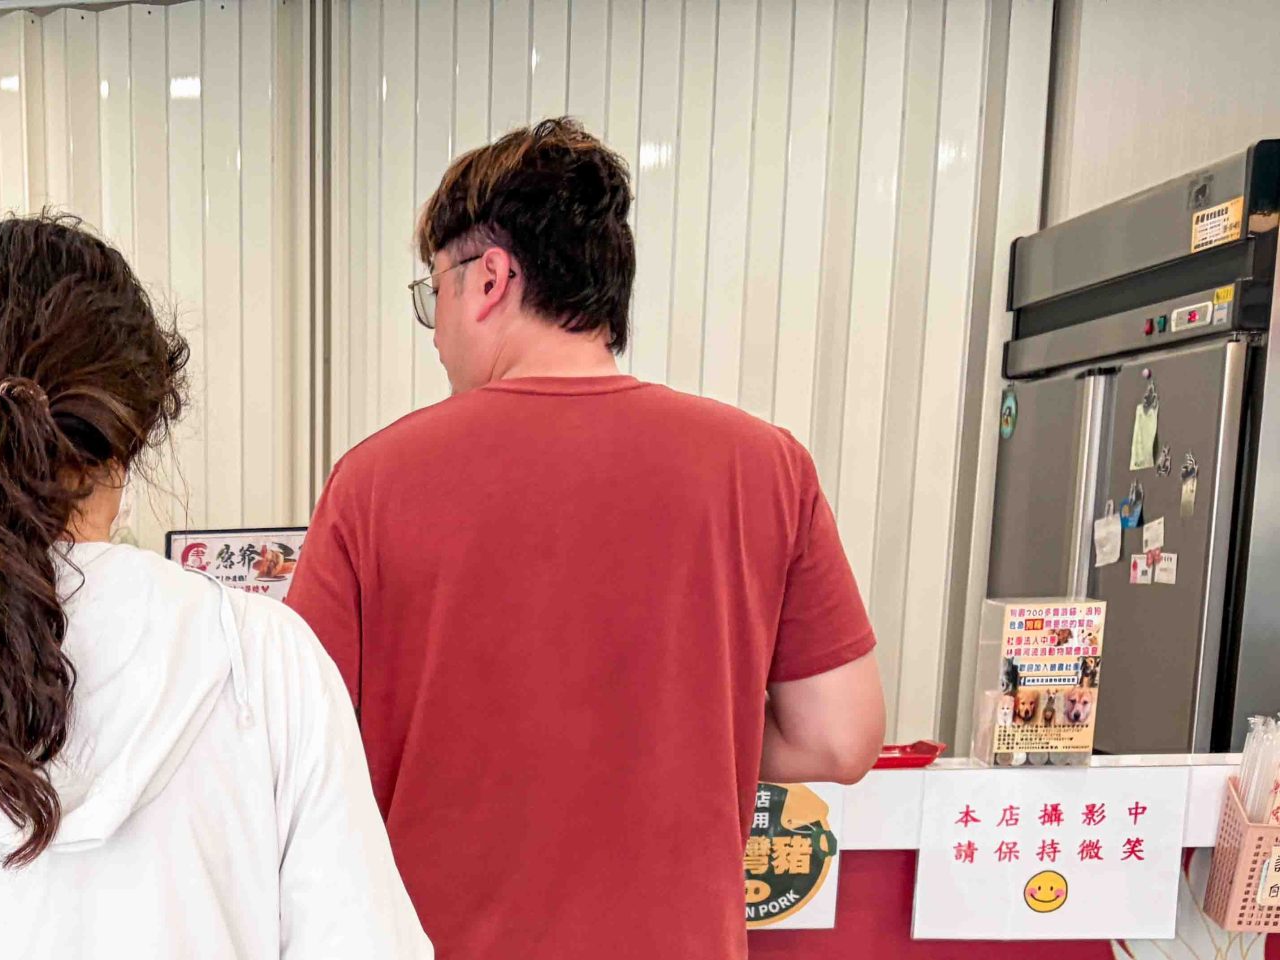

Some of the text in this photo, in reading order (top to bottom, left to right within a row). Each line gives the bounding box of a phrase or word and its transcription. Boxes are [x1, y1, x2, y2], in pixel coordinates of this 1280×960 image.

[954, 800, 1148, 828] 本店攝影中
[952, 836, 1146, 864] 請保持微笑
[759, 888, 801, 918] PORK
